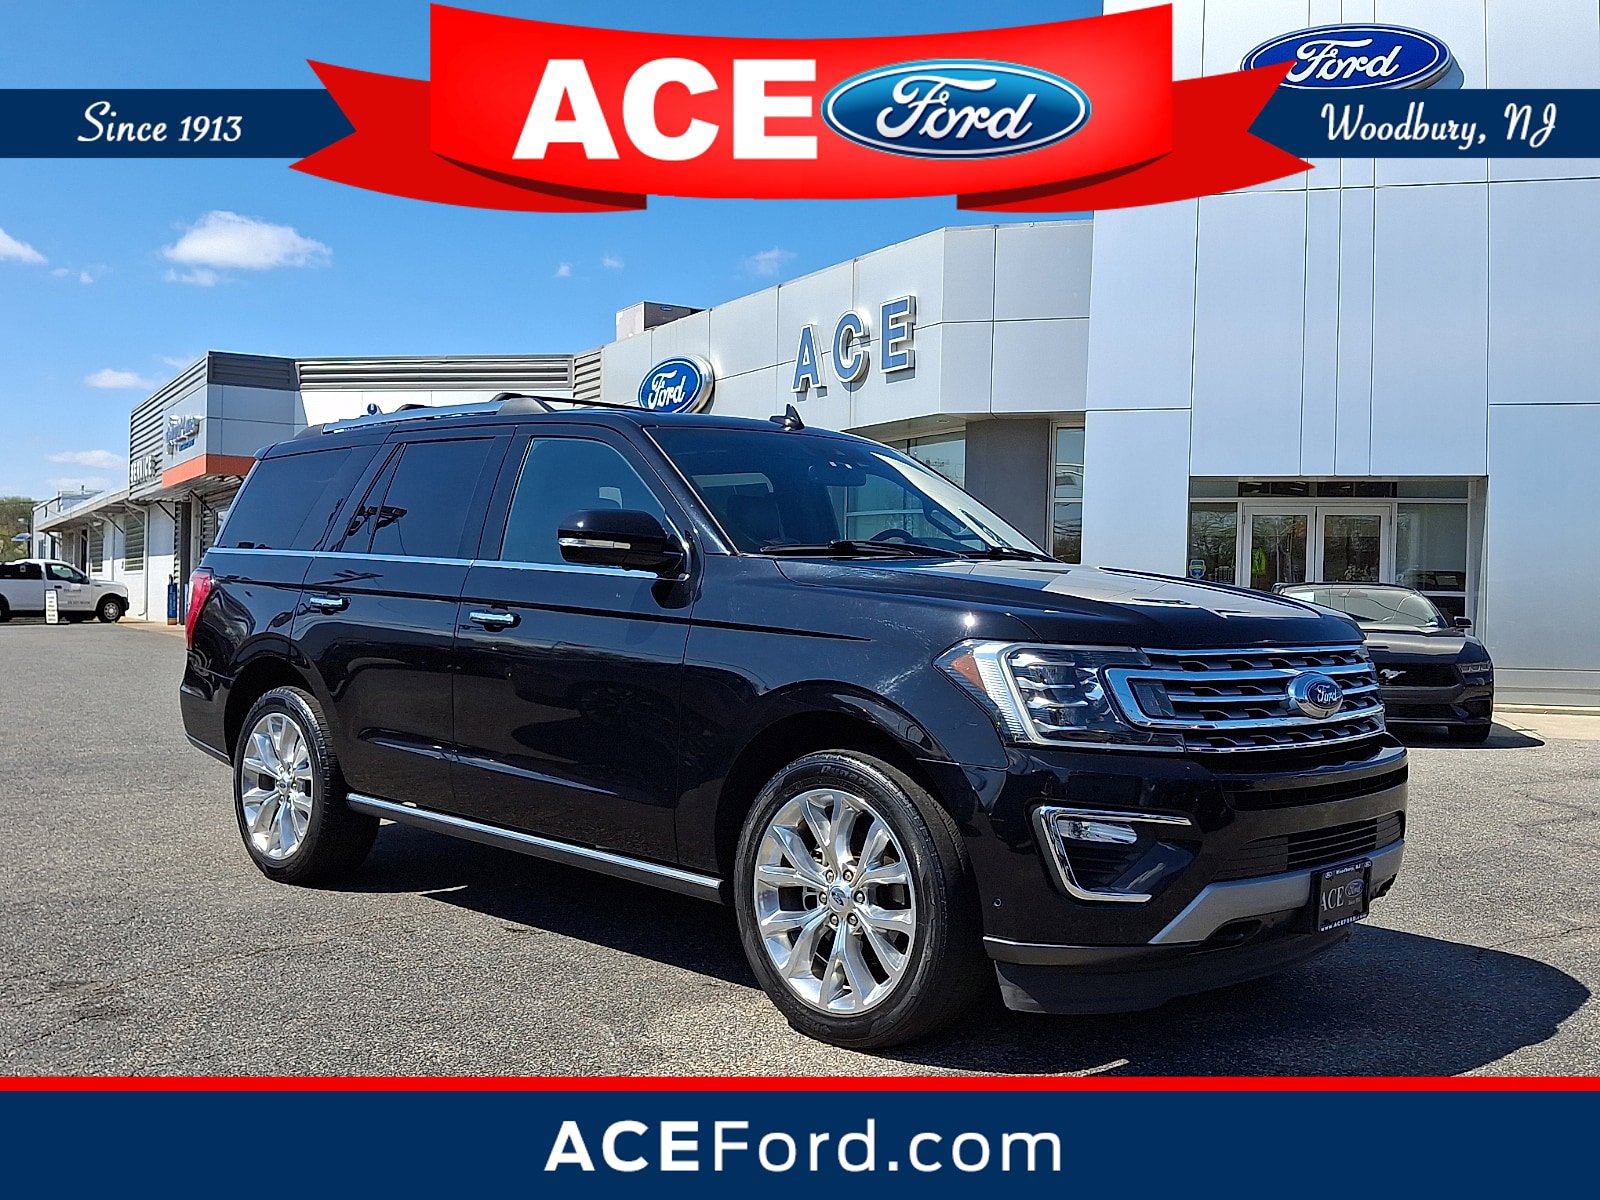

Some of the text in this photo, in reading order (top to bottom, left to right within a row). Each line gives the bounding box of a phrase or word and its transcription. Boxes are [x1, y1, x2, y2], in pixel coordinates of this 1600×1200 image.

[1285, 38, 1403, 82] Ford
[790, 294, 917, 394] ACE
[648, 368, 686, 407] Ford
[1317, 685, 1340, 703] Ford
[1320, 886, 1344, 911] ACE
